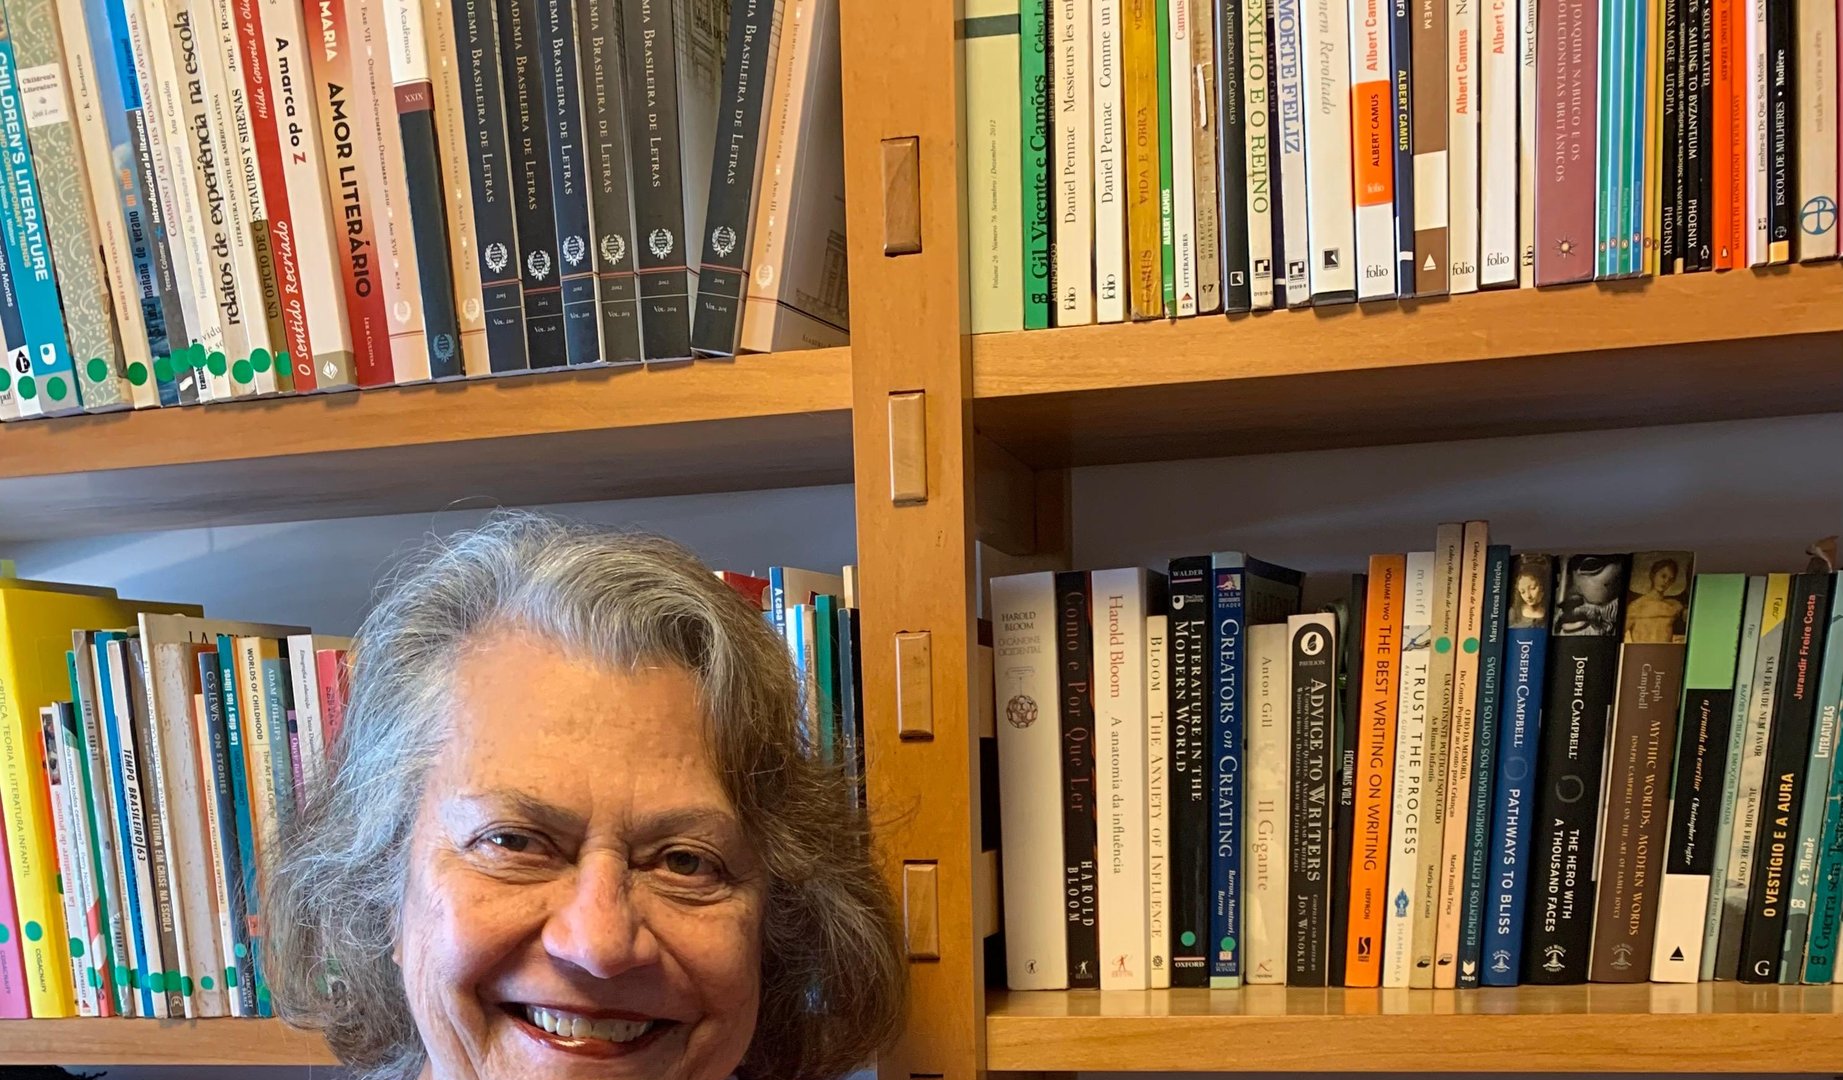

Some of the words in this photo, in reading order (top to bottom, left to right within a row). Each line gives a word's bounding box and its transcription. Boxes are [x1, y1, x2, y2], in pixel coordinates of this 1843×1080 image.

[174, 10, 199, 75] escola
[275, 37, 289, 52] A
[319, 1, 339, 62] MARIA
[1034, 20, 1045, 53] Celso
[1063, 24, 1074, 43] les
[1278, 0, 1297, 80] MORTE
[1688, 27, 1698, 71] SAILING
[278, 56, 296, 117] marca
[472, 49, 486, 125] BRASILEIRA
[1063, 45, 1075, 113] Messieurs
[1688, 74, 1698, 91] TO
[1776, 49, 1785, 87] Molière
[188, 81, 203, 104] na
[1250, 87, 1266, 104] E
[1398, 69, 1407, 109] ALBERT
[232, 88, 250, 144] SIRENAS
[327, 82, 353, 160] AMOR
[1030, 75, 1047, 152] Camões
[1250, 111, 1267, 128] O
[1282, 82, 1300, 154] FELIZ
[1371, 94, 1379, 128] CAMUS
[1687, 95, 1698, 160] BYZANTIUM
[1776, 101, 1785, 152] MULHERES
[241, 146, 251, 154] Y
[289, 122, 303, 147] do
[480, 131, 489, 148] DE
[1064, 126, 1076, 175] Pennac
[1371, 131, 1380, 167] ALBERT
[1398, 112, 1408, 151] CAMUS
[193, 113, 224, 225] experiência
[293, 152, 307, 165] Z
[482, 152, 495, 203] LETRAS
[1036, 157, 1047, 169] e
[1251, 134, 1269, 214] REINO
[1776, 154, 1784, 166] DE
[243, 157, 264, 231] CENTAUROS
[1064, 178, 1077, 224] Daniel
[1776, 168, 1785, 207] ESCOLA
[17, 168, 49, 282] LITERATURE
[1030, 172, 1048, 244] Vicente
[1687, 199, 1697, 249] PHOENIX
[212, 233, 229, 258] de
[256, 234, 268, 252] DE
[339, 165, 372, 298] LITERÁRIO
[259, 254, 275, 299] OFICIO
[272, 220, 299, 295] Recriado
[1031, 249, 1048, 279] Gil
[1366, 266, 1389, 280] folio
[220, 263, 241, 325] relatos
[267, 301, 279, 320] UN
[1064, 287, 1077, 311] folio
[286, 299, 310, 361] Sentido
[298, 364, 312, 376] O
[1384, 567, 1394, 601] VOLUME
[1109, 595, 1125, 646] Harold
[1383, 603, 1391, 621] TWO
[1377, 625, 1393, 655] THE
[247, 648, 257, 681] WORLDS
[1110, 649, 1125, 698] Bloom
[1175, 621, 1190, 700] MODERN
[1191, 620, 1205, 738] LITERATURE
[1219, 619, 1240, 724] CREATORS
[1374, 661, 1390, 695] BEST
[1517, 640, 1533, 682] JOSEPH
[1573, 656, 1588, 697] JOSEPH
[250, 683, 258, 693] OF
[1412, 664, 1427, 723] TRUST
[252, 694, 264, 741] CHILDHOOD
[1111, 716, 1122, 727] A
[1309, 679, 1328, 751] ADVICE
[1370, 700, 1388, 769] WRITING
[1513, 686, 1530, 748] CAMPBELL
[1568, 700, 1585, 760] CAMPBELL
[1175, 706, 1190, 773] WORLD
[1191, 740, 1202, 759] IN
[1223, 731, 1234, 750] on
[1409, 732, 1423, 768] THE
[123, 749, 136, 782] TEMPO
[1111, 731, 1125, 789] anatomia
[1308, 757, 1323, 782] TO
[1112, 794, 1124, 808] da
[1191, 765, 1202, 802] THE
[1368, 774, 1383, 798] ON
[1779, 773, 1795, 812] AURA
[1218, 755, 1238, 858] CREATING
[1404, 776, 1420, 855] PROCESS
[1554, 818, 1565, 827] A
[1776, 817, 1789, 827] A
[1112, 813, 1126, 875] influência
[1307, 783, 1326, 881] WRITERS
[1363, 801, 1380, 871] WRITING
[1503, 789, 1521, 865] PATHWAYS
[1567, 829, 1580, 852] THE
[1774, 831, 1787, 839] E
[1501, 870, 1514, 889] TO
[1548, 830, 1564, 894] THOUSAND
[1565, 855, 1578, 887] HERO
[1765, 841, 1785, 904] VESTÍGIO
[1498, 894, 1512, 935] BLISS
[1545, 896, 1558, 933] FACES
[1562, 891, 1574, 919] WITH
[1763, 908, 1777, 918] O
